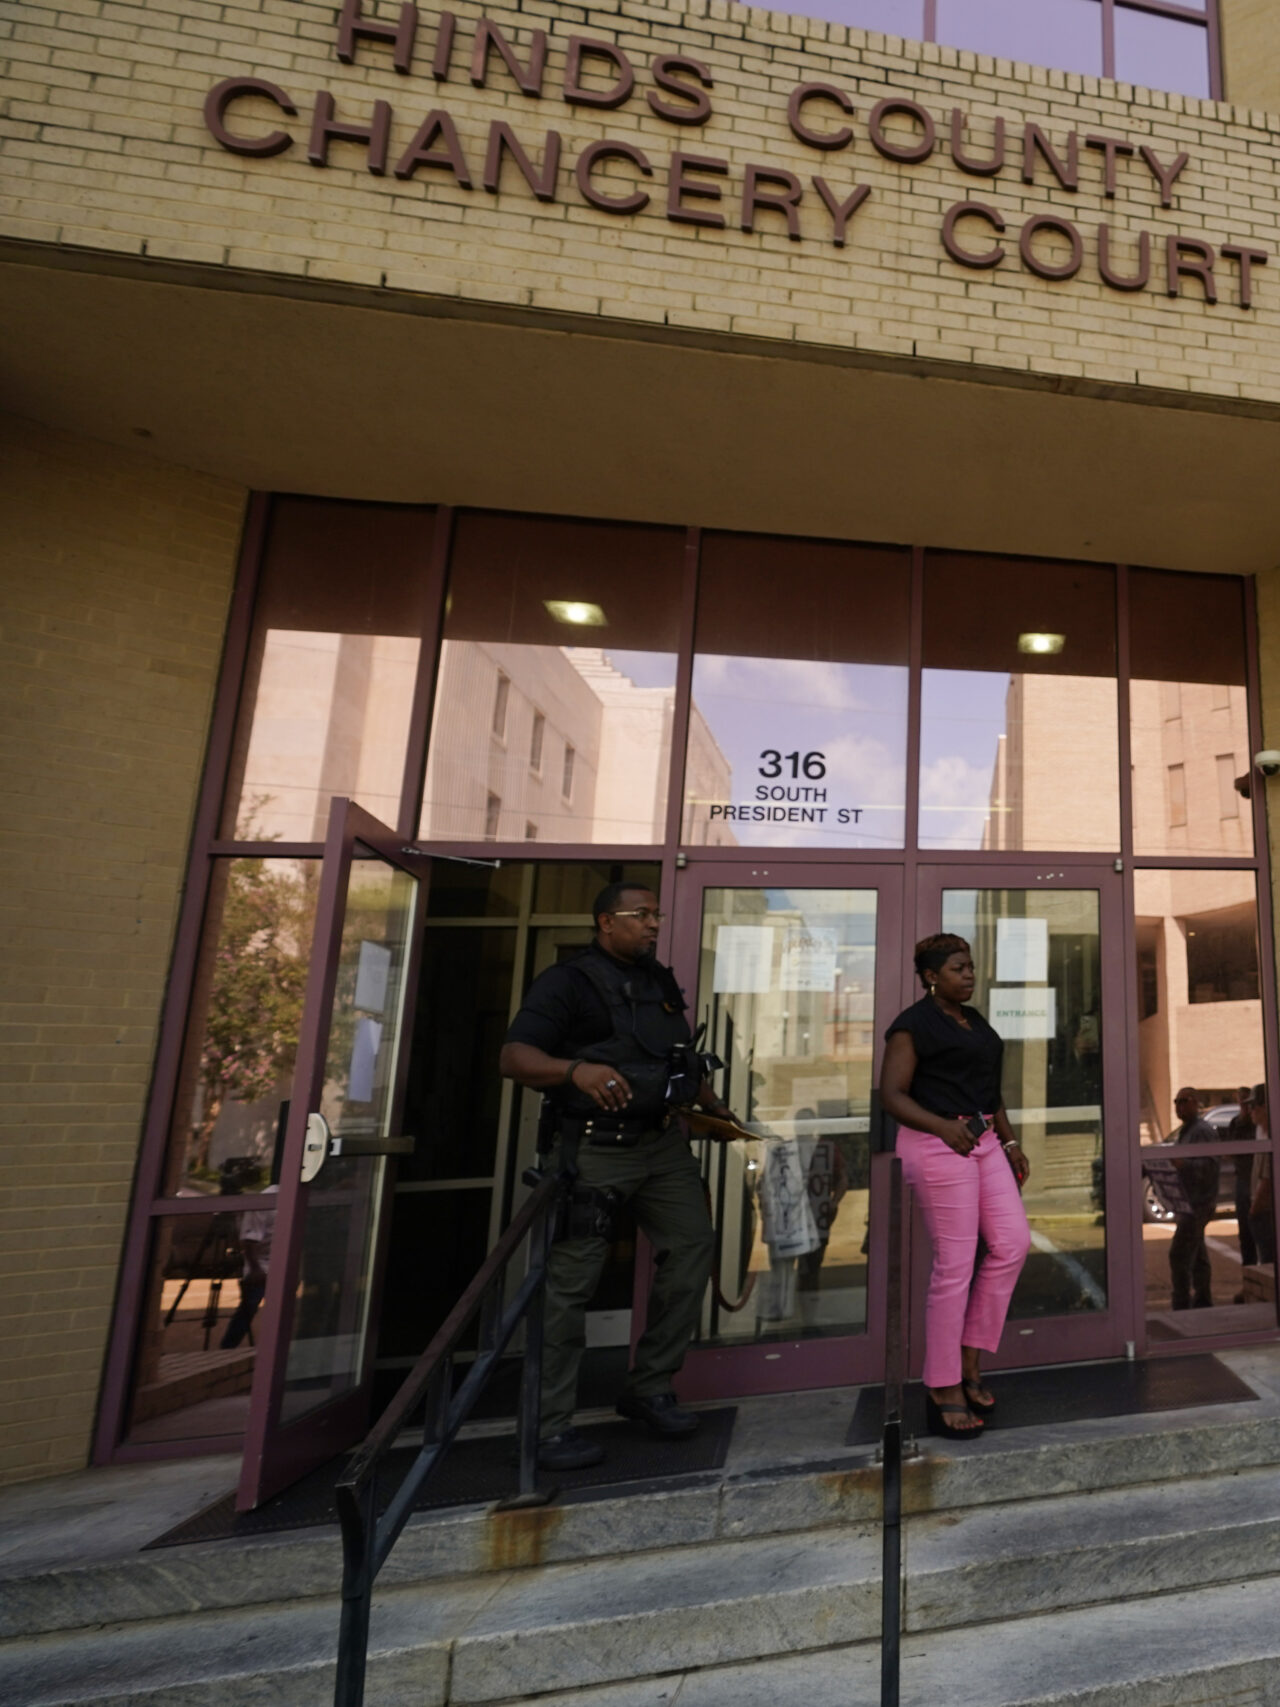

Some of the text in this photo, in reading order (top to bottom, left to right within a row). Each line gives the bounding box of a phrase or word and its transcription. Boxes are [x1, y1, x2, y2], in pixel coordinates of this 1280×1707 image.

[336, 0, 1190, 210] HINDS COUNTY
[203, 75, 1269, 310] CHANCERY COURT
[757, 749, 827, 781] 316
[755, 785, 827, 803] SOUTH
[709, 804, 863, 824] PRESIDENT ST
[996, 1009, 1047, 1017] ENTRANCE
